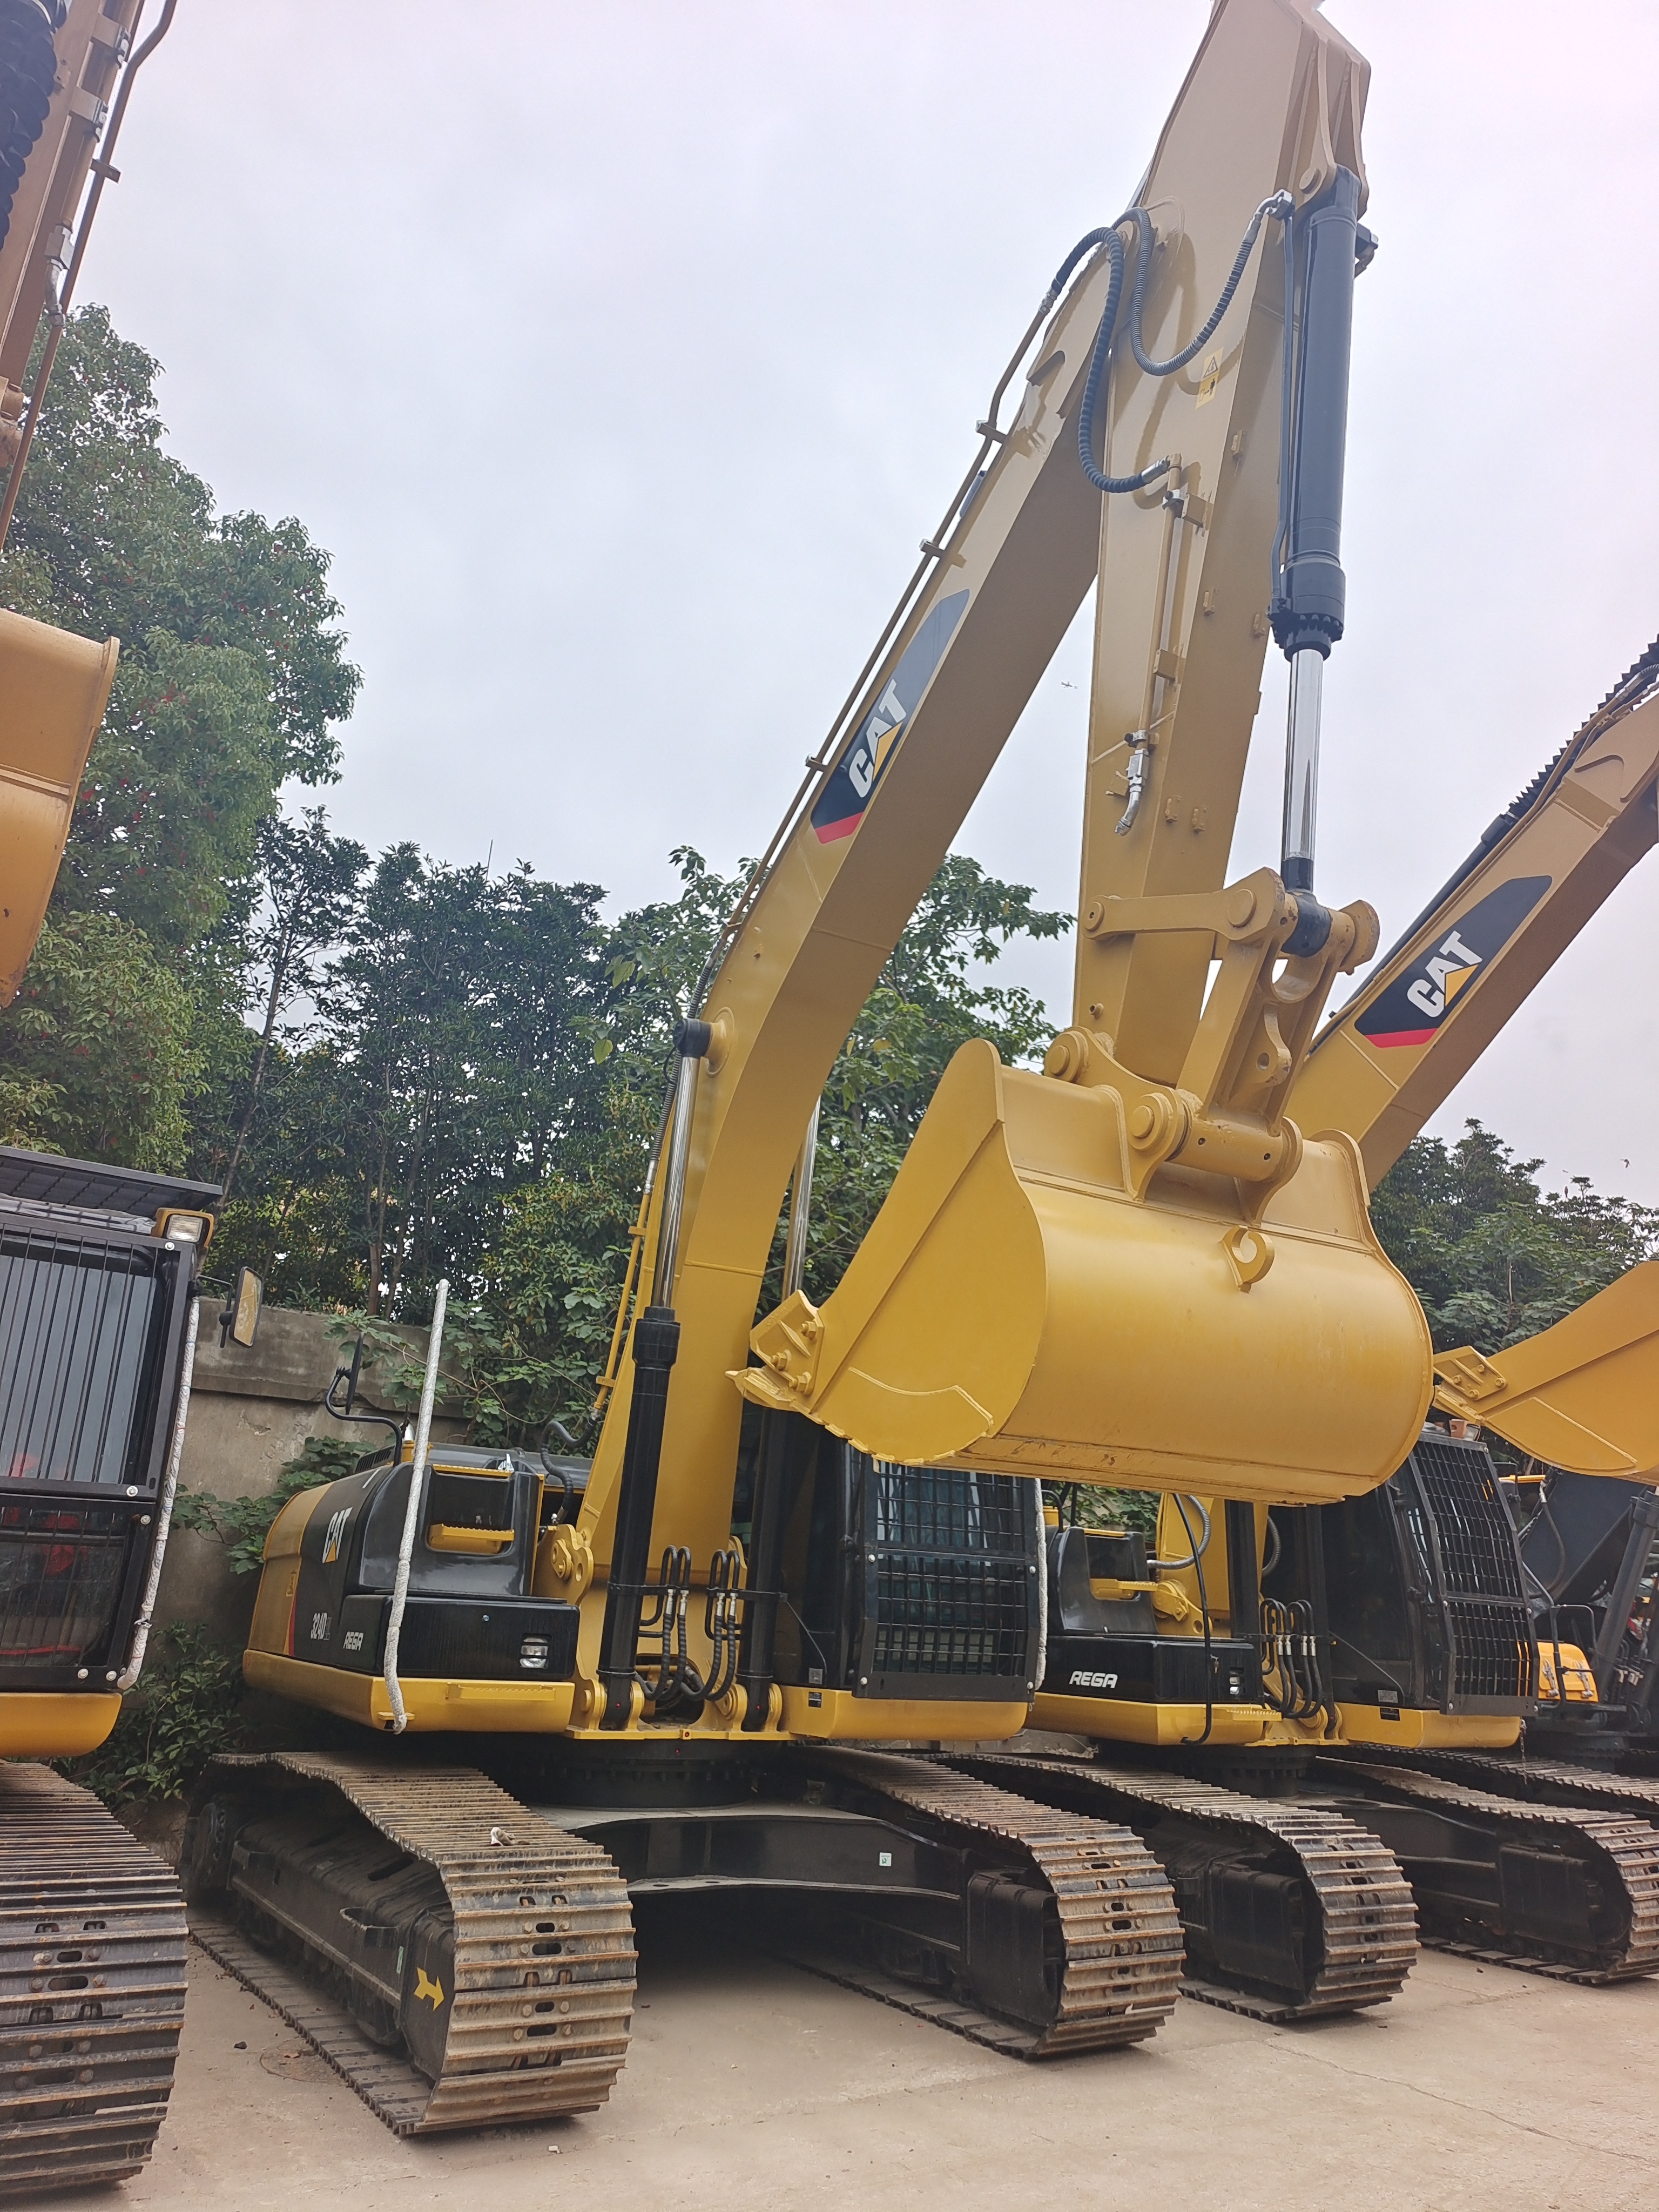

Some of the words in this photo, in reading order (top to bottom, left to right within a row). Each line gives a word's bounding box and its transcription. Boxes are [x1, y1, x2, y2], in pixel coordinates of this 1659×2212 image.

[849, 678, 907, 798] CAT
[1407, 930, 1483, 1018] CAT
[322, 1506, 353, 1563] CAT
[343, 1631, 364, 1651] REGA
[1069, 1670, 1118, 1689] REGA
